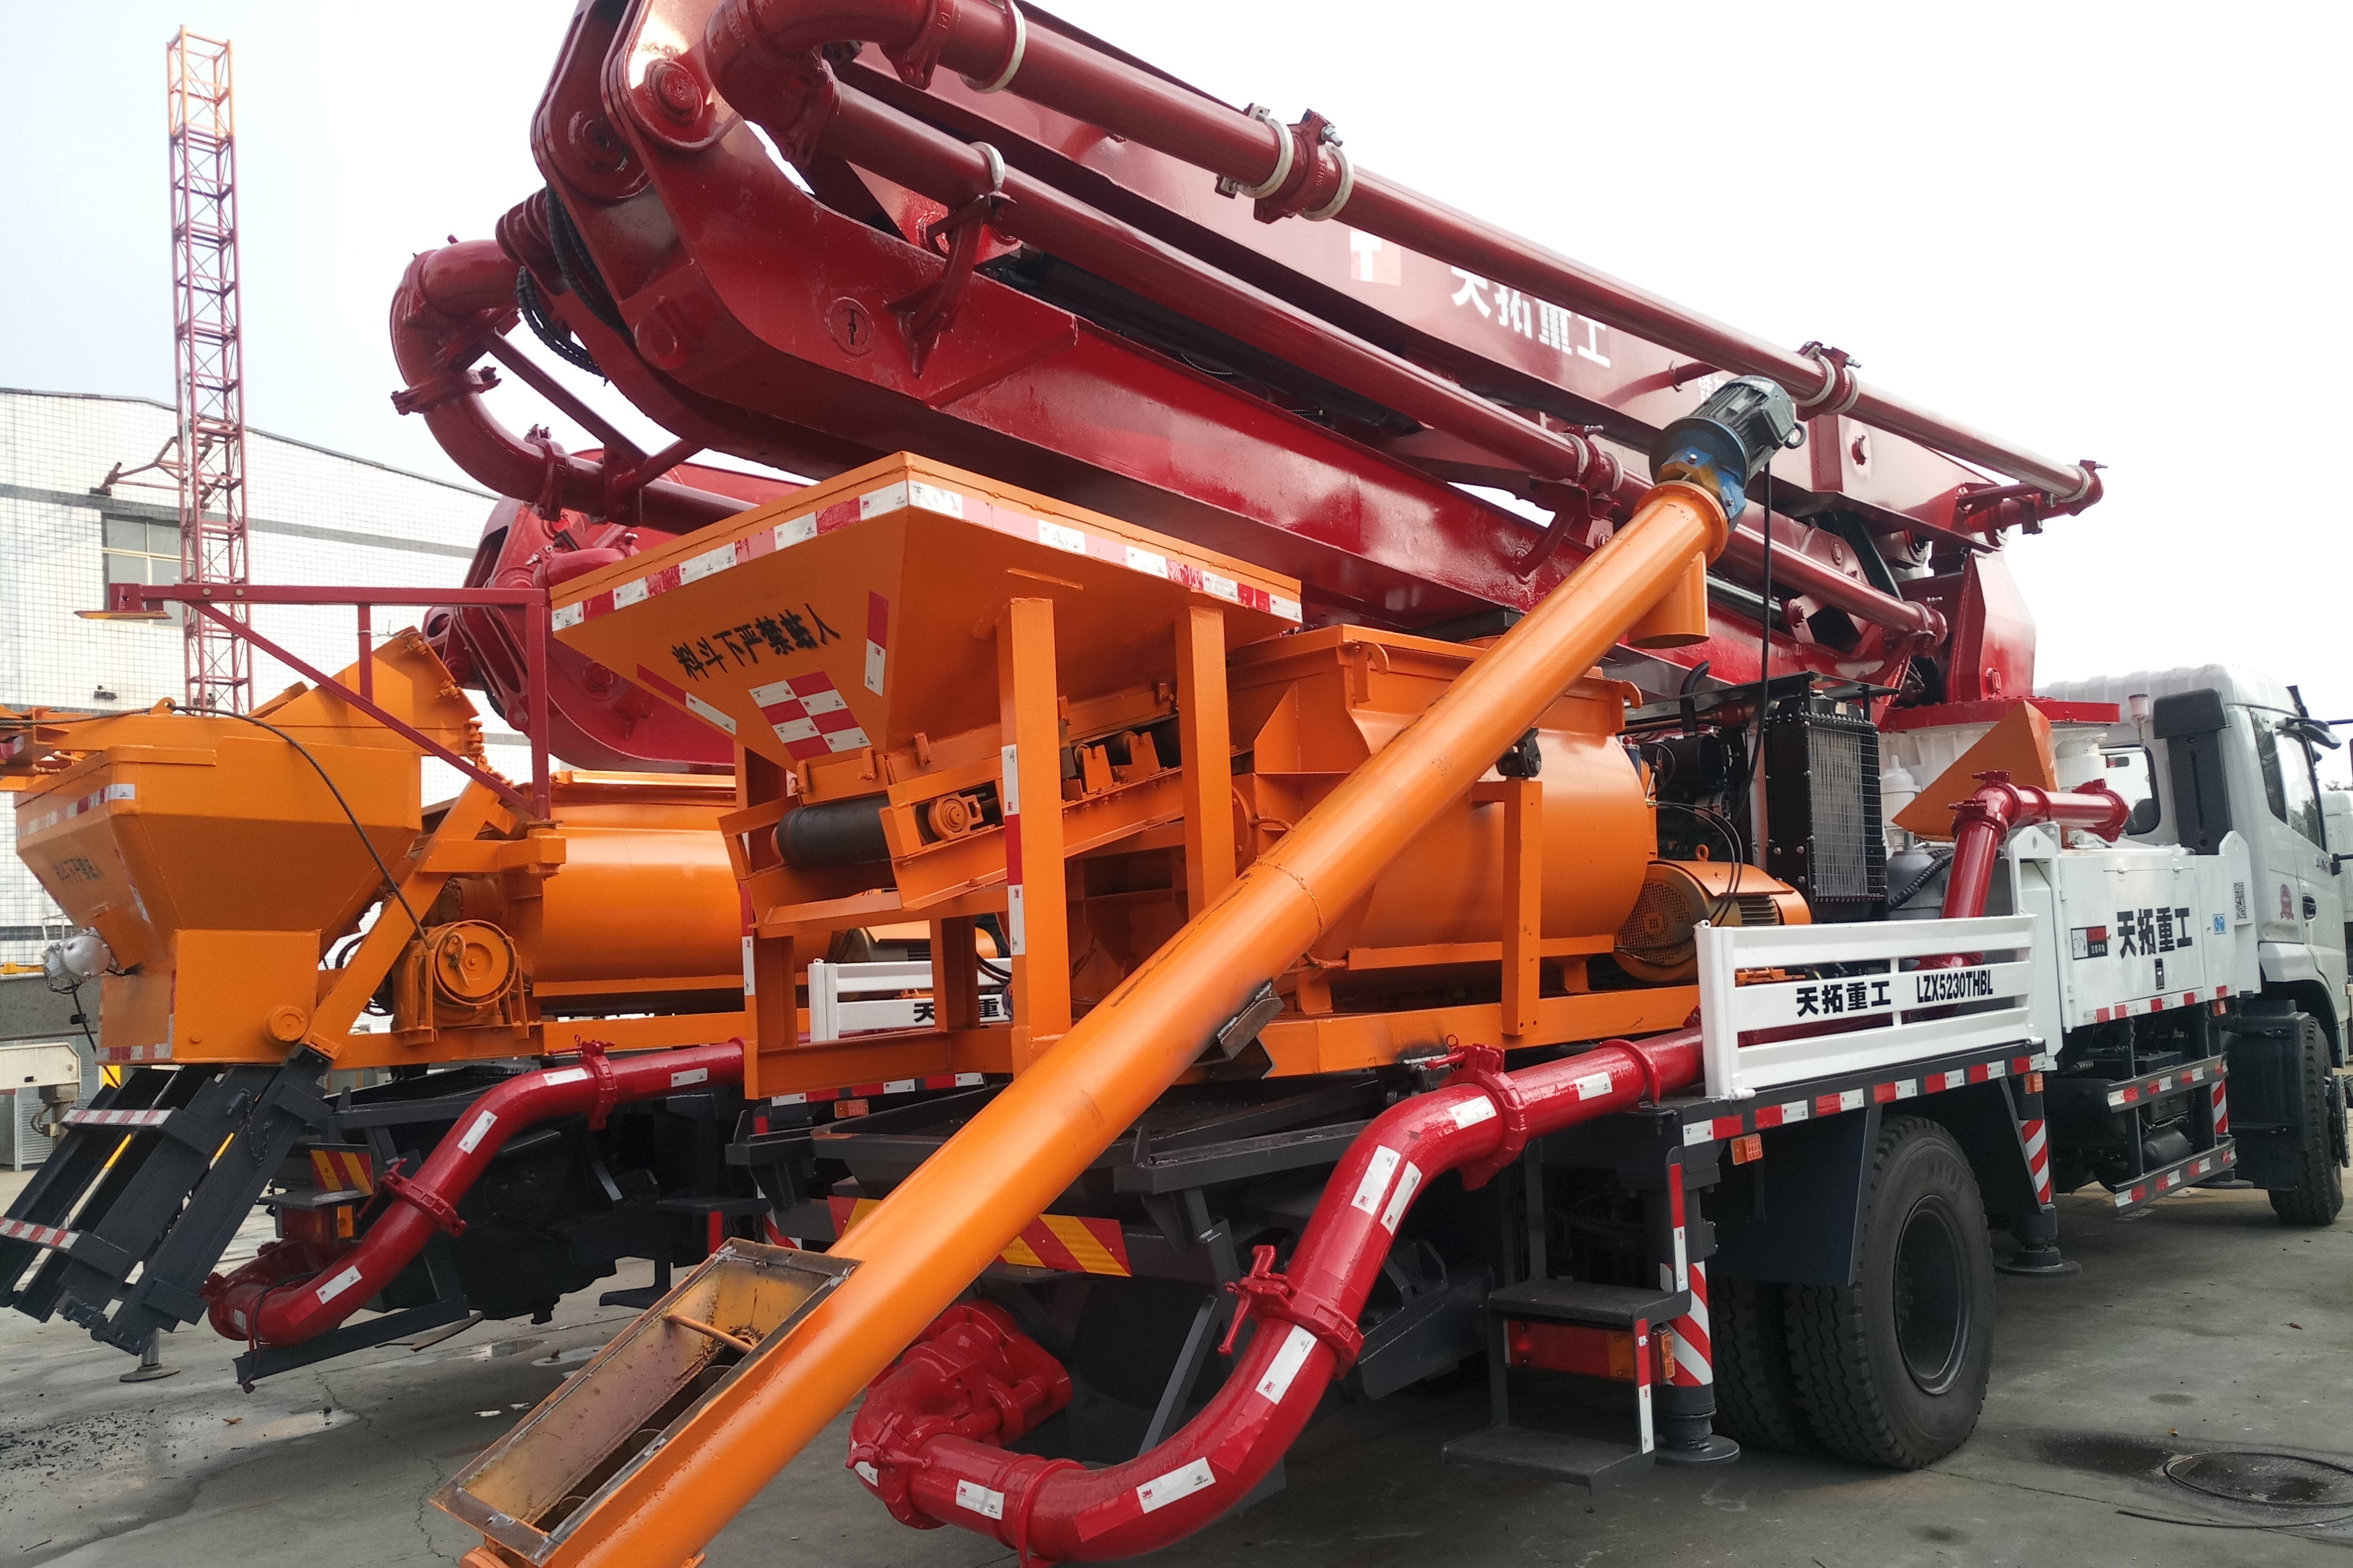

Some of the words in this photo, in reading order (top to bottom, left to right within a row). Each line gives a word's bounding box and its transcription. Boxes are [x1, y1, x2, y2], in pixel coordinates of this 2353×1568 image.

[2117, 907, 2192, 959] 天拓重工
[1797, 980, 1891, 1017] 天拓重工
[1917, 970, 1993, 1003] LZX5230THBL
